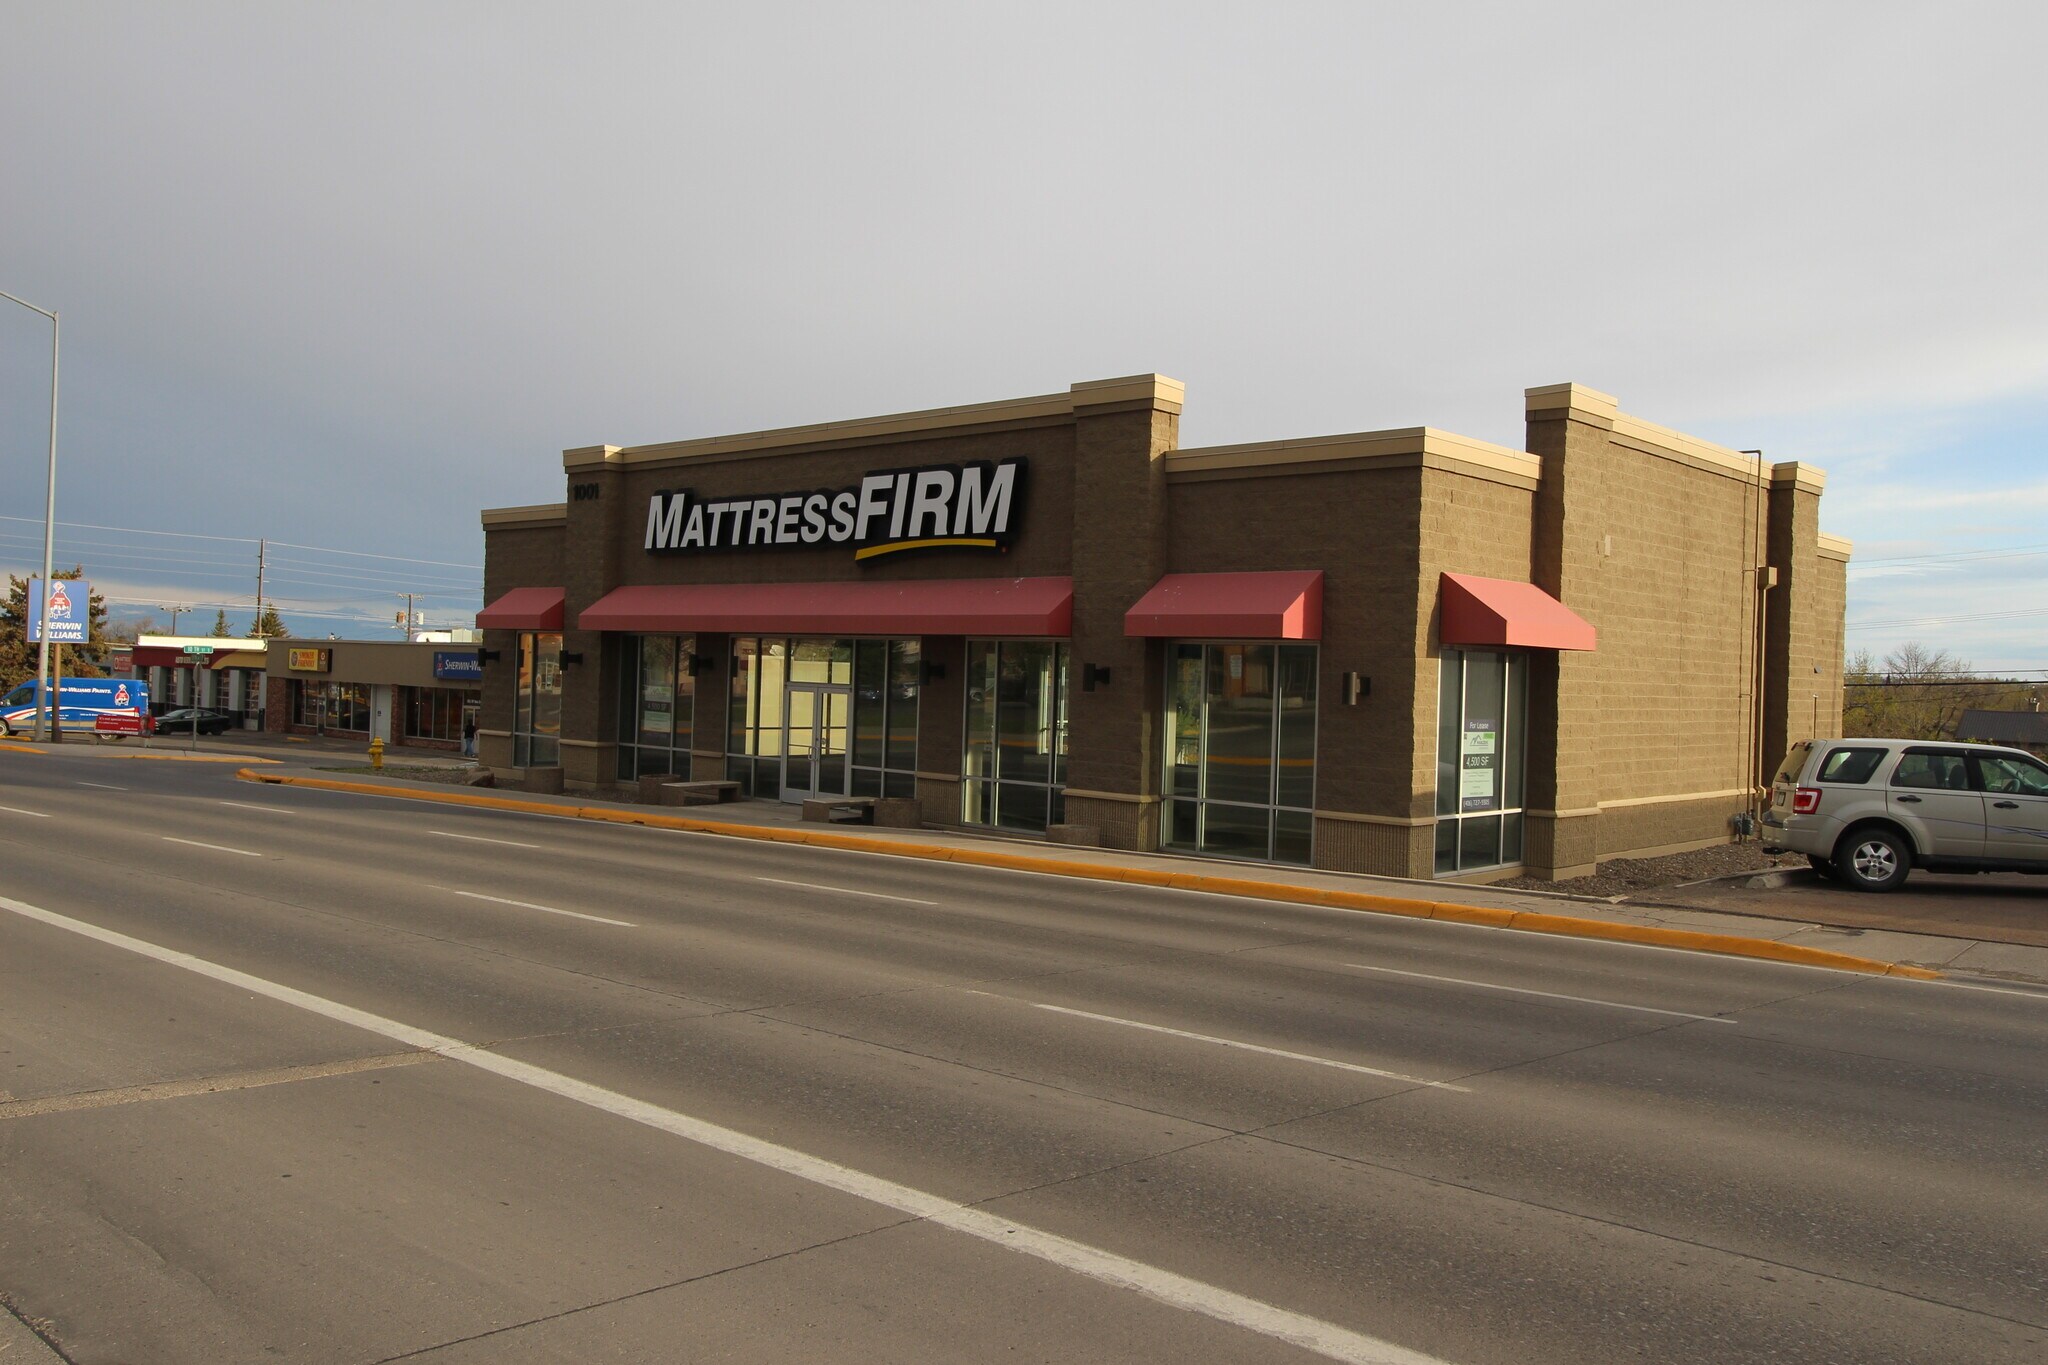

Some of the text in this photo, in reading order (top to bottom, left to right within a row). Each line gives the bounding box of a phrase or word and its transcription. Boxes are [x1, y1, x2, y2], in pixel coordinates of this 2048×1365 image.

[573, 483, 599, 501] 1001
[36, 620, 82, 630] SERWIN
[36, 629, 84, 640] WLLIAMS.
[1469, 721, 1489, 730] For Lease
[1466, 756, 1490, 767] 4,500 SF
